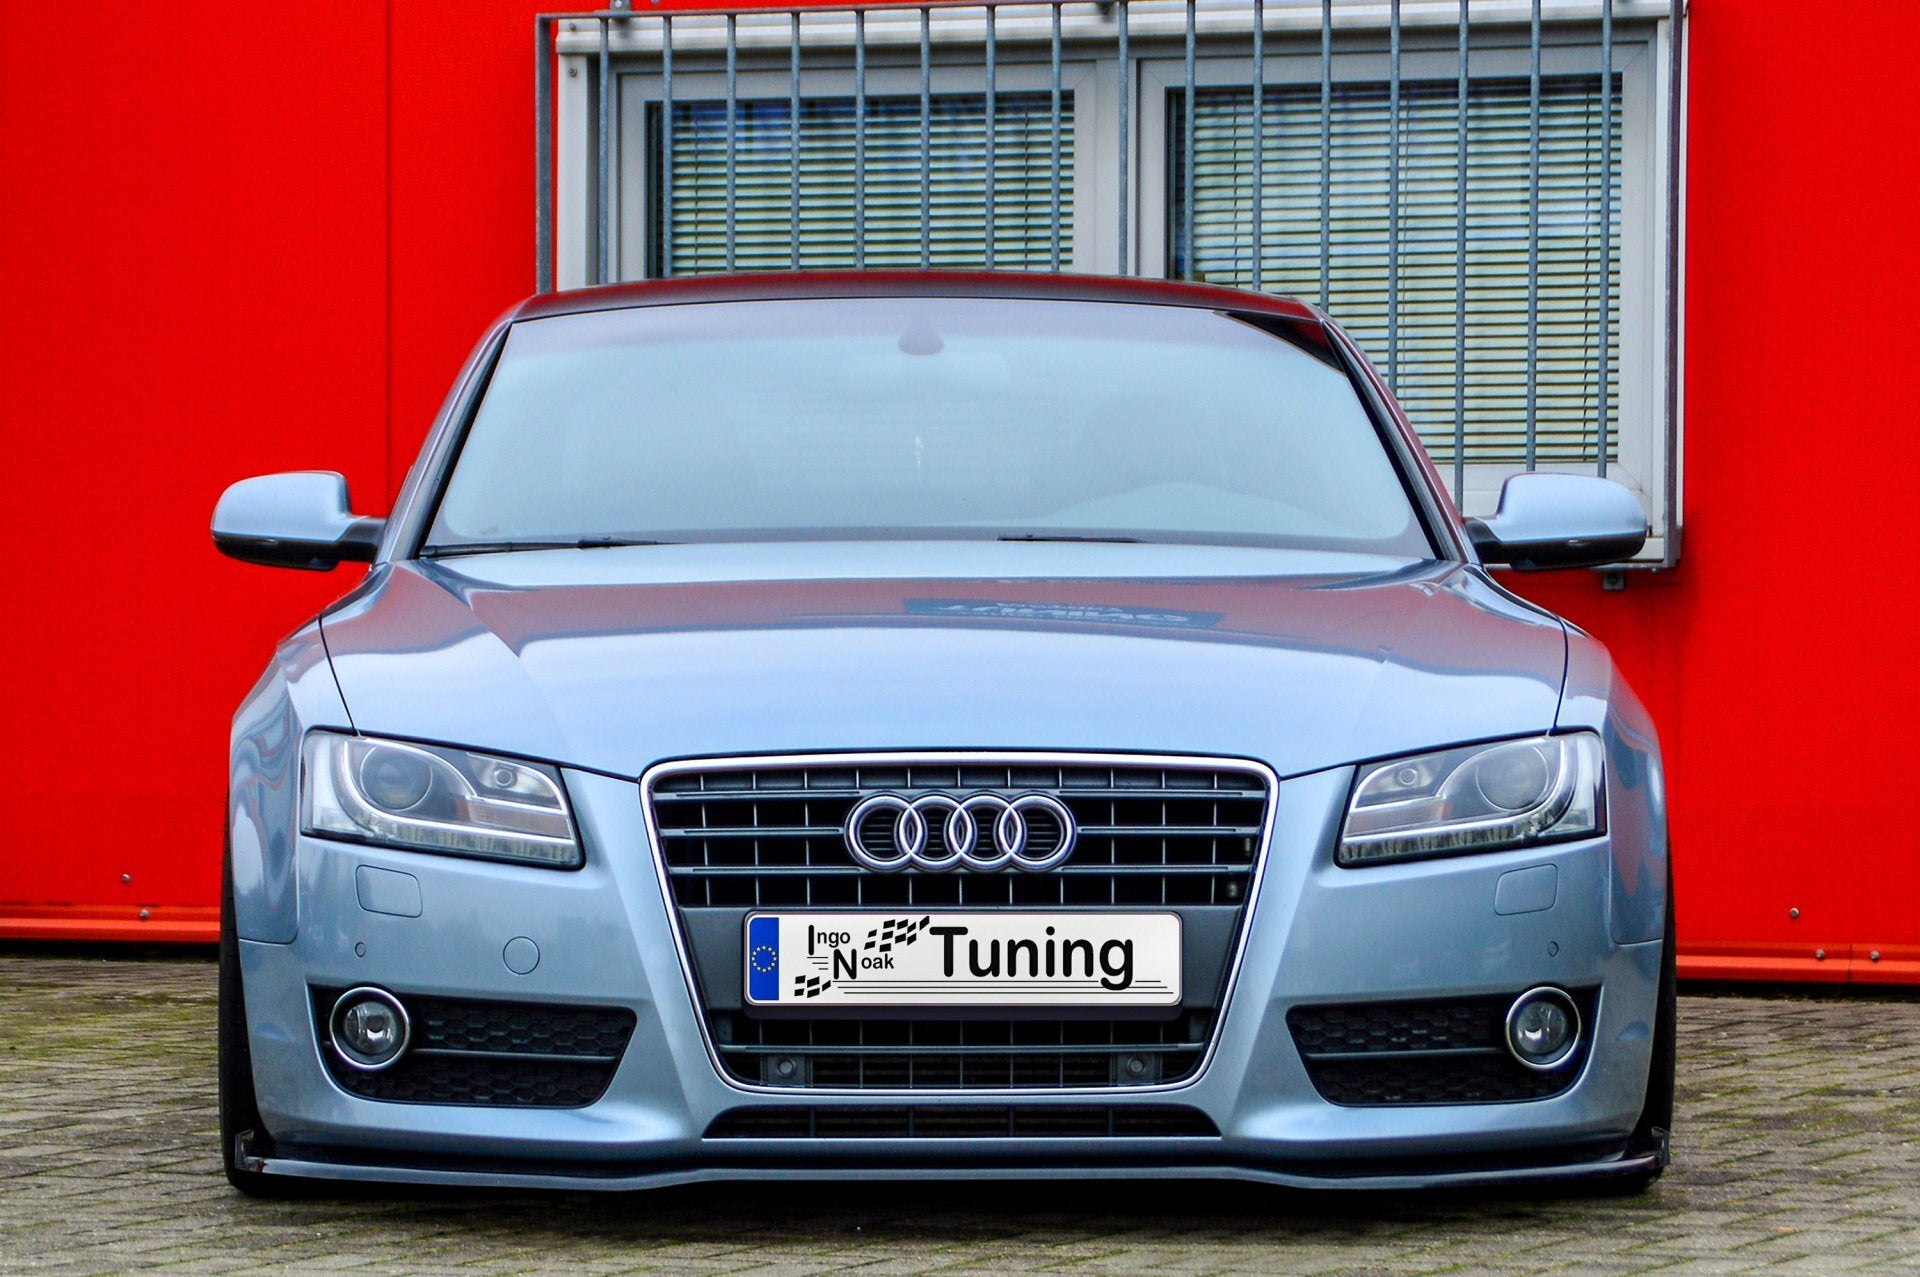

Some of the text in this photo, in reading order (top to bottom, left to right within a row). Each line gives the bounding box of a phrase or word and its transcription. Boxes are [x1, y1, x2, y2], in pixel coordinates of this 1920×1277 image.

[808, 924, 851, 955] Ingo
[833, 948, 894, 980] Noak
[929, 926, 1134, 990] Tuning
